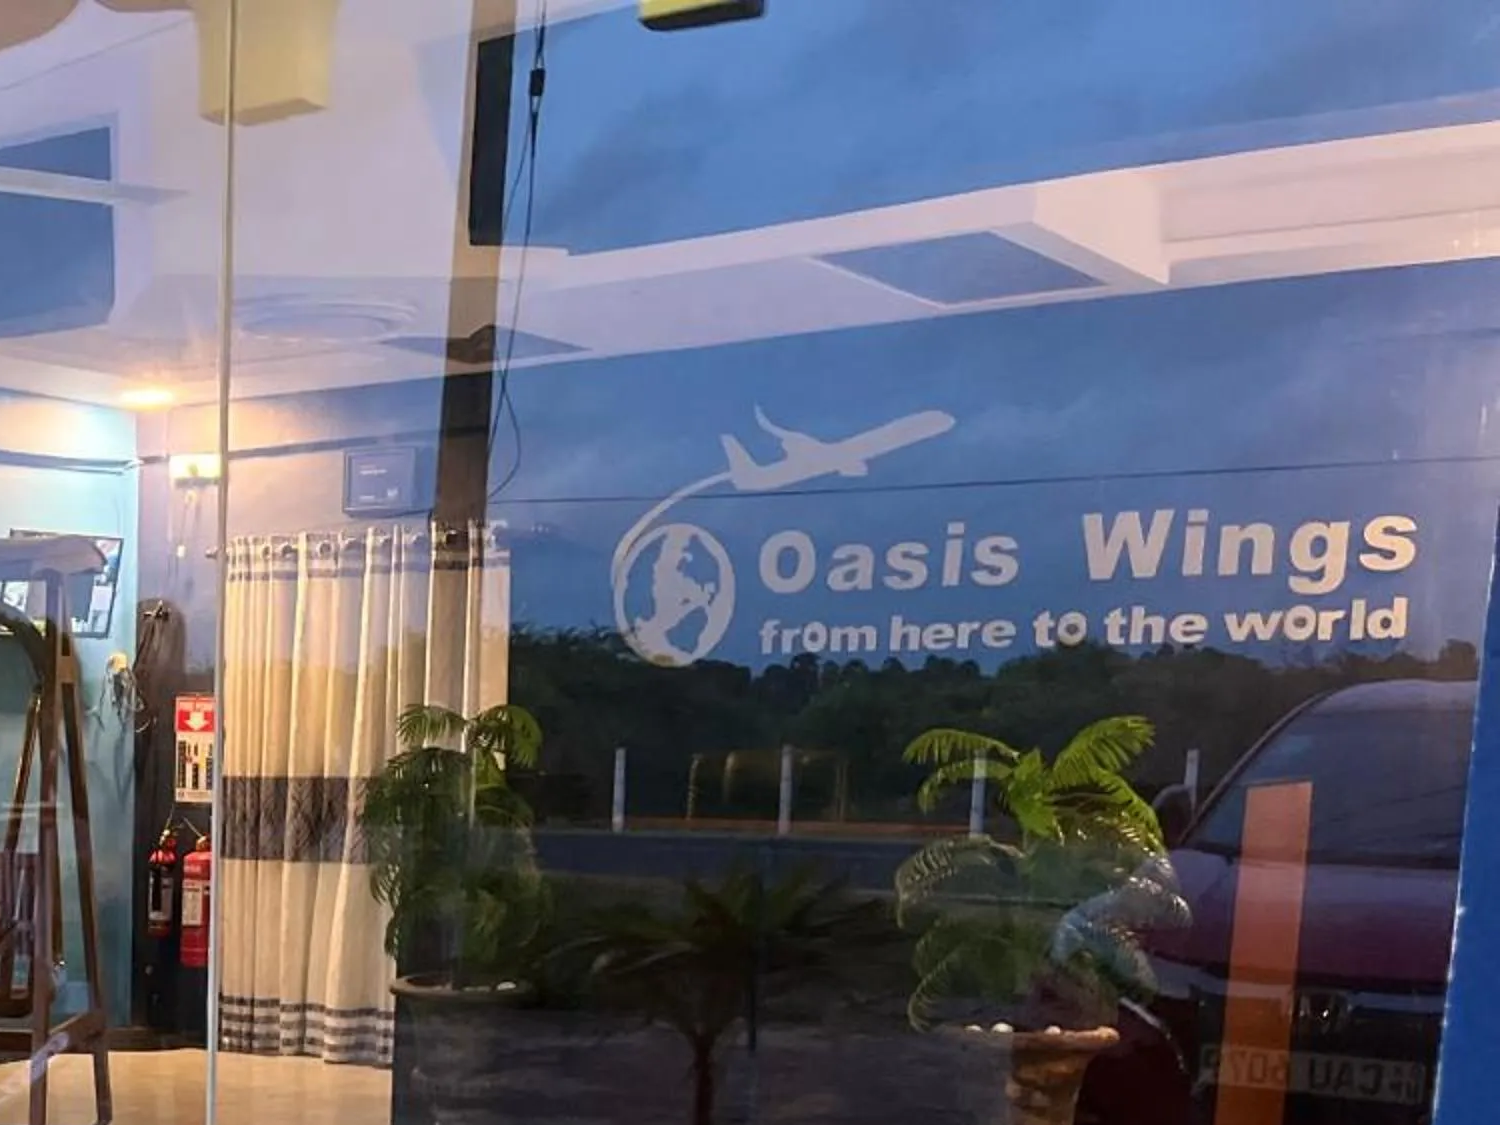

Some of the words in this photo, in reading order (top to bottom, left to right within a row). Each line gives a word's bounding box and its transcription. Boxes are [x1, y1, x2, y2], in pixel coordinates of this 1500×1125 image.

[757, 521, 1020, 594] Oasis
[1082, 508, 1418, 596] Wings
[758, 618, 878, 656] from
[888, 619, 1016, 652] here
[1032, 611, 1088, 648] to
[1104, 606, 1209, 646] the
[1223, 597, 1408, 643] world
